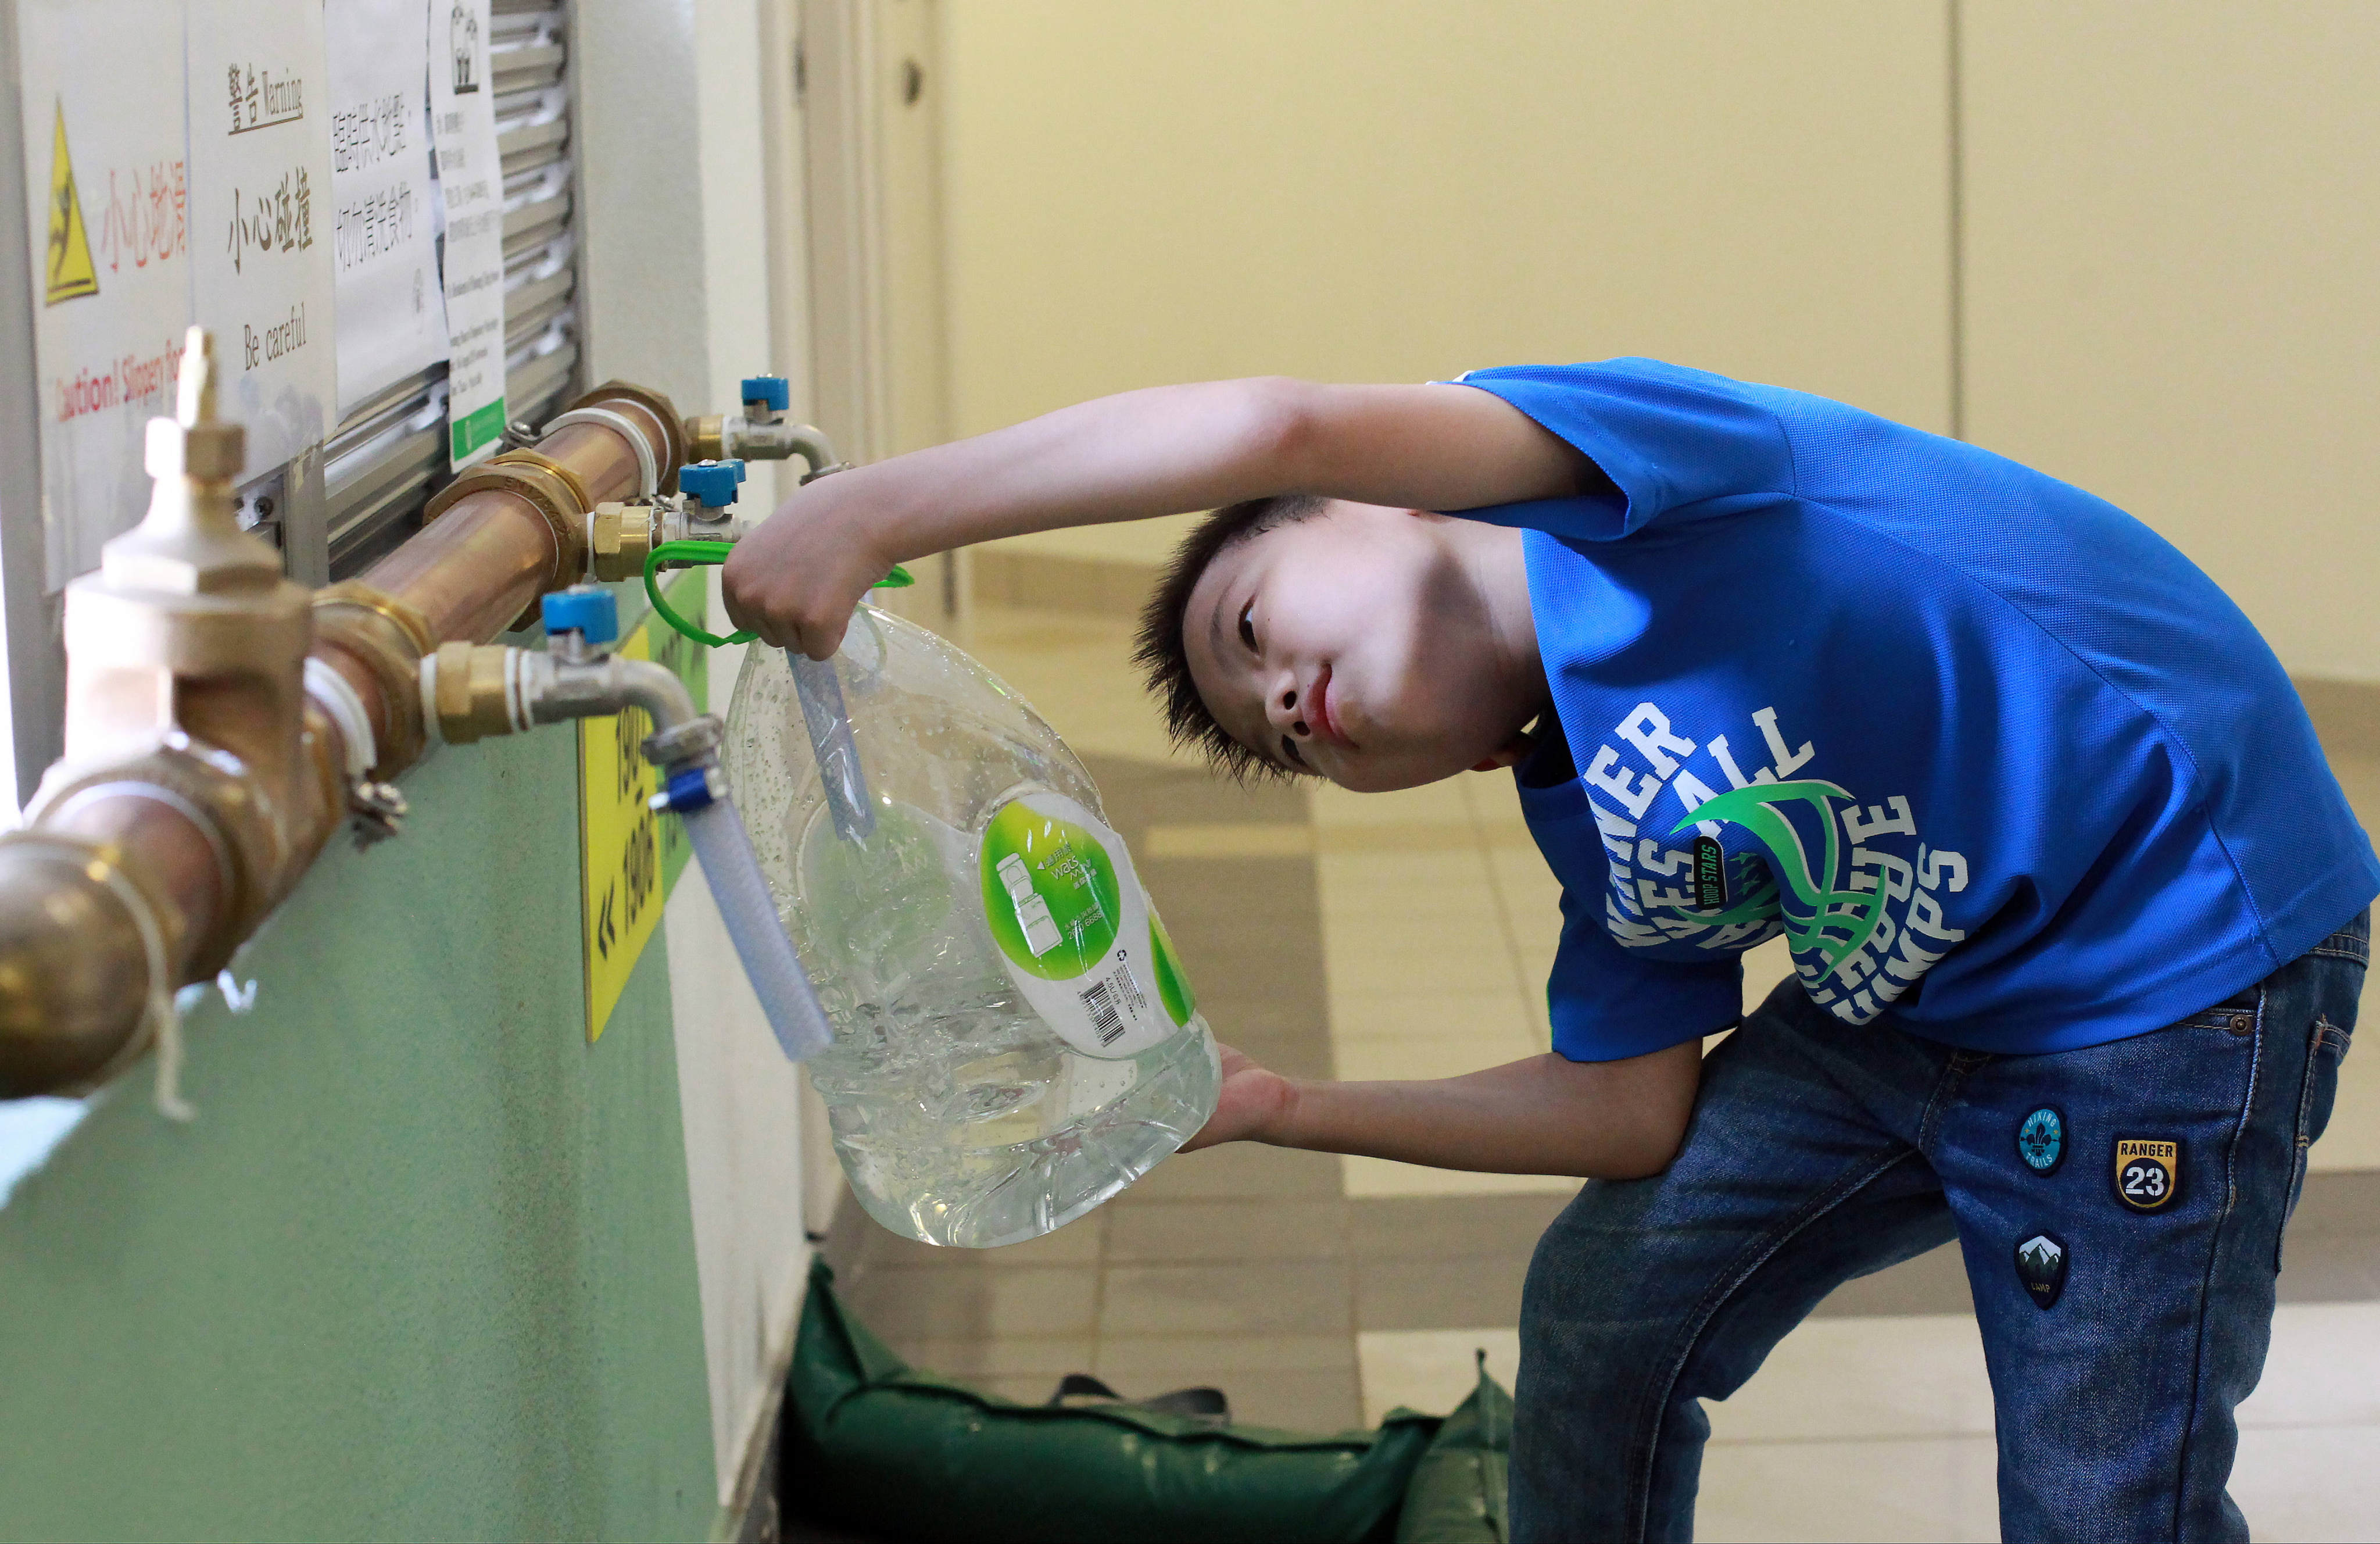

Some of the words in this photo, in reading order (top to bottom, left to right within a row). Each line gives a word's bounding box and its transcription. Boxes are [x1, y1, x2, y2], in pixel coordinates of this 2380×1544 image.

[228, 63, 258, 131] 警告
[227, 165, 313, 276] 小心碰撞
[243, 323, 259, 371] Be
[266, 301, 307, 362] careful
[1050, 854, 1080, 881] wats
[1701, 844, 1718, 882] STARS
[1703, 884, 1720, 905] HOOP
[2027, 1111, 2057, 1128] HIKING
[2026, 1152, 2053, 1168] TRAILS
[2120, 1142, 2173, 1158] RANGER
[2125, 1166, 2164, 1197] 23
